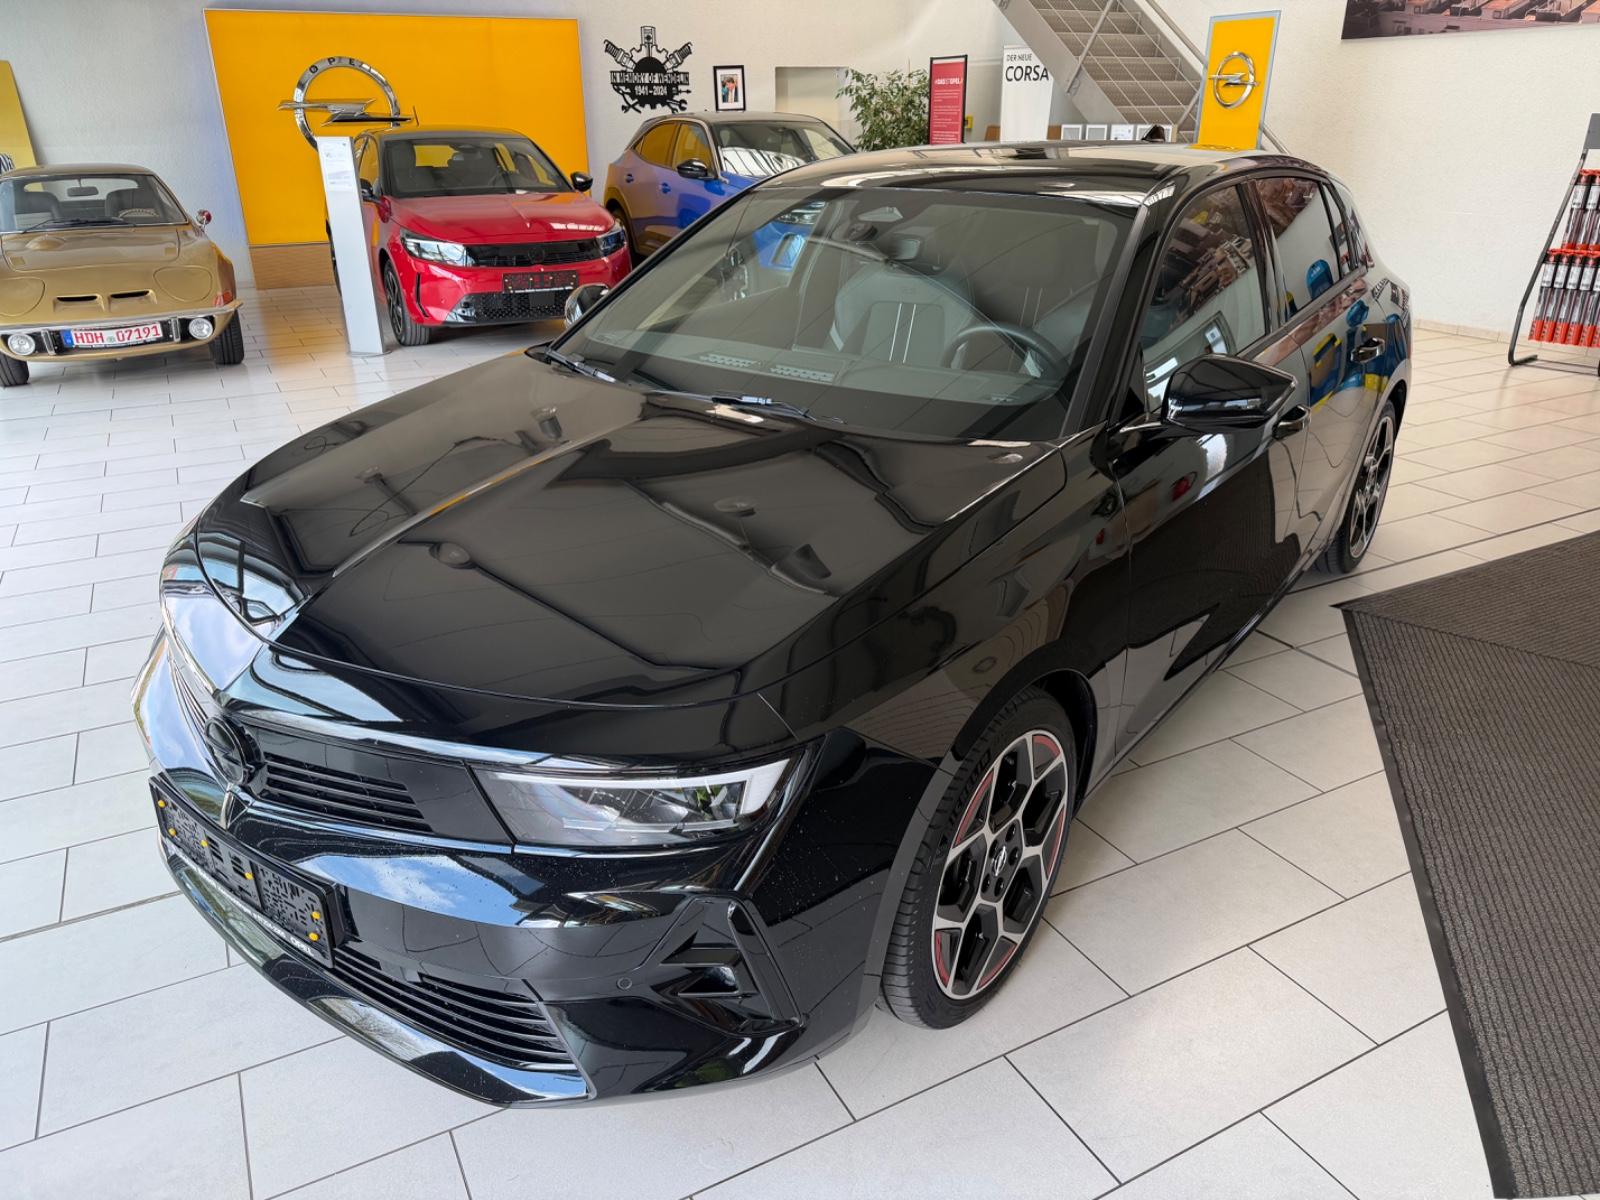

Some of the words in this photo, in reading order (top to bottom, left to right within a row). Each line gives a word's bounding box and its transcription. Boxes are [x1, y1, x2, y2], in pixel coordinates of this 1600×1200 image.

[309, 56, 372, 74] OPEL
[1006, 54, 1017, 62] DER
[1018, 53, 1032, 61] NEUE
[611, 72, 617, 83] IN
[619, 72, 646, 84] MEMORY
[648, 72, 656, 84] OF
[1005, 65, 1049, 81] CORSA
[74, 332, 105, 344] HDH
[115, 325, 160, 342] 07191
